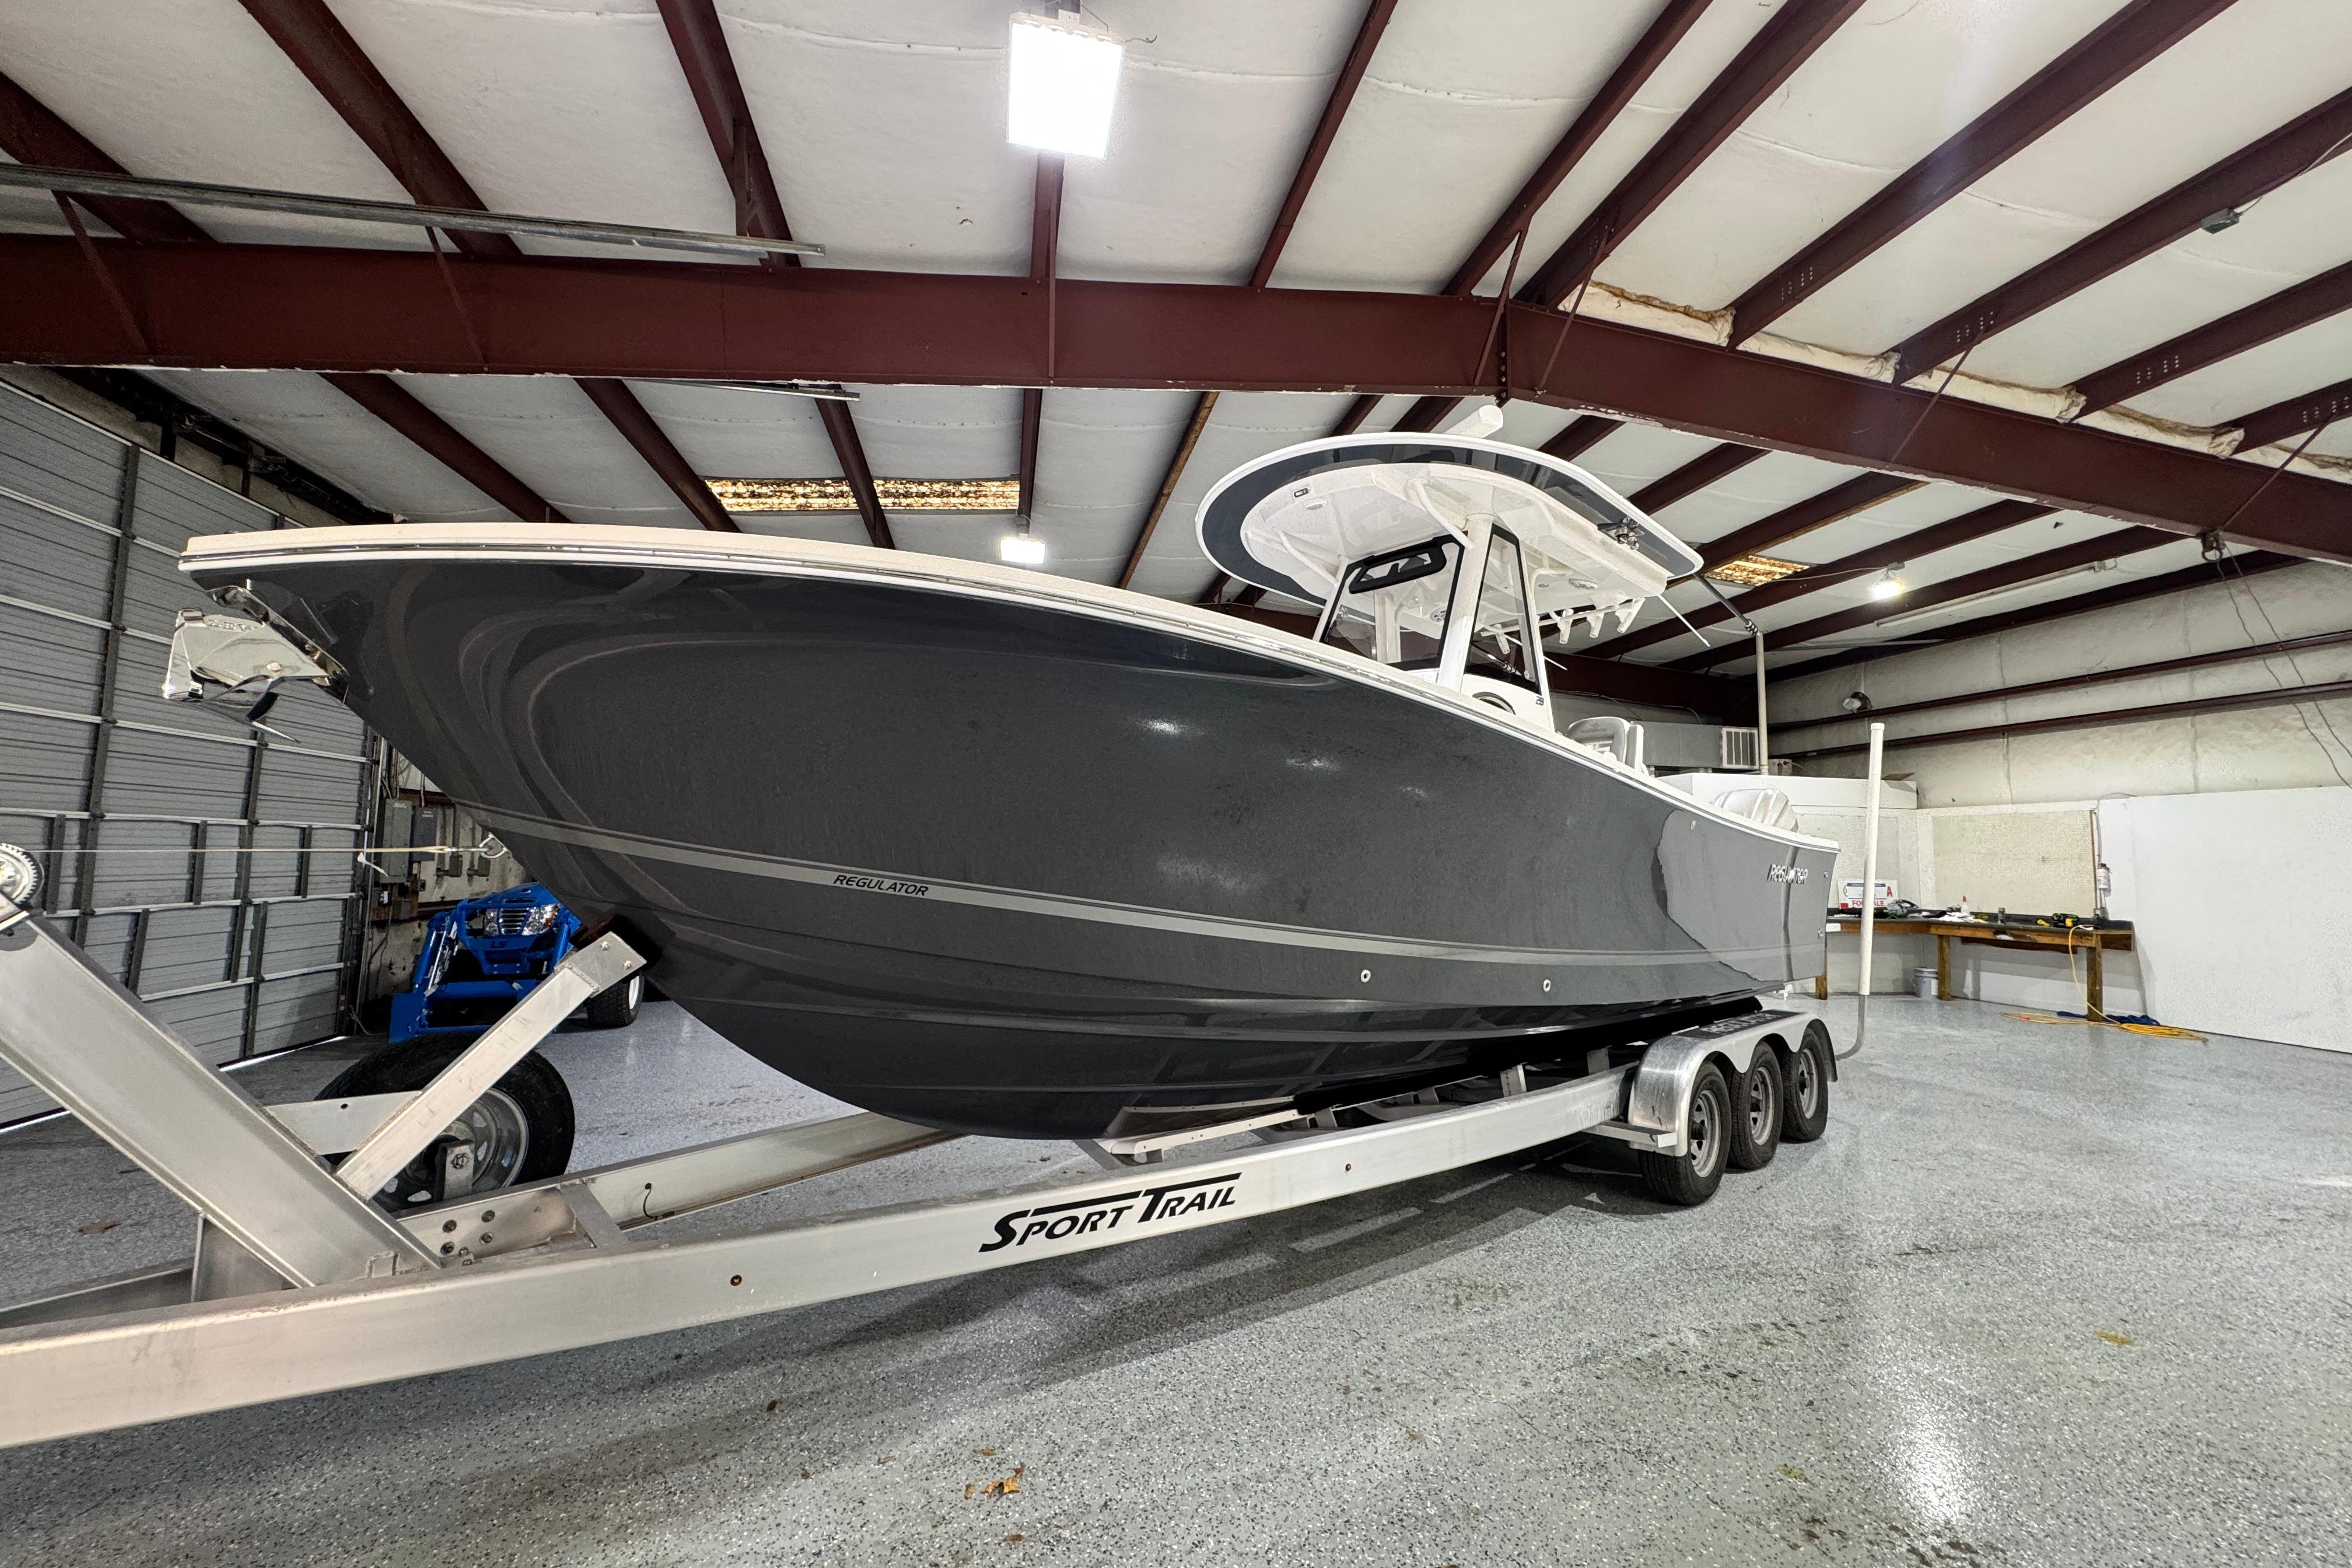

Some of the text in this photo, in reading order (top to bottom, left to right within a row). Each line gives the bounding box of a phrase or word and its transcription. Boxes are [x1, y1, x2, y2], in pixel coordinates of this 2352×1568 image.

[833, 874, 929, 896] REGULATOR
[978, 1172, 1242, 1253] SPORT TRAIL
